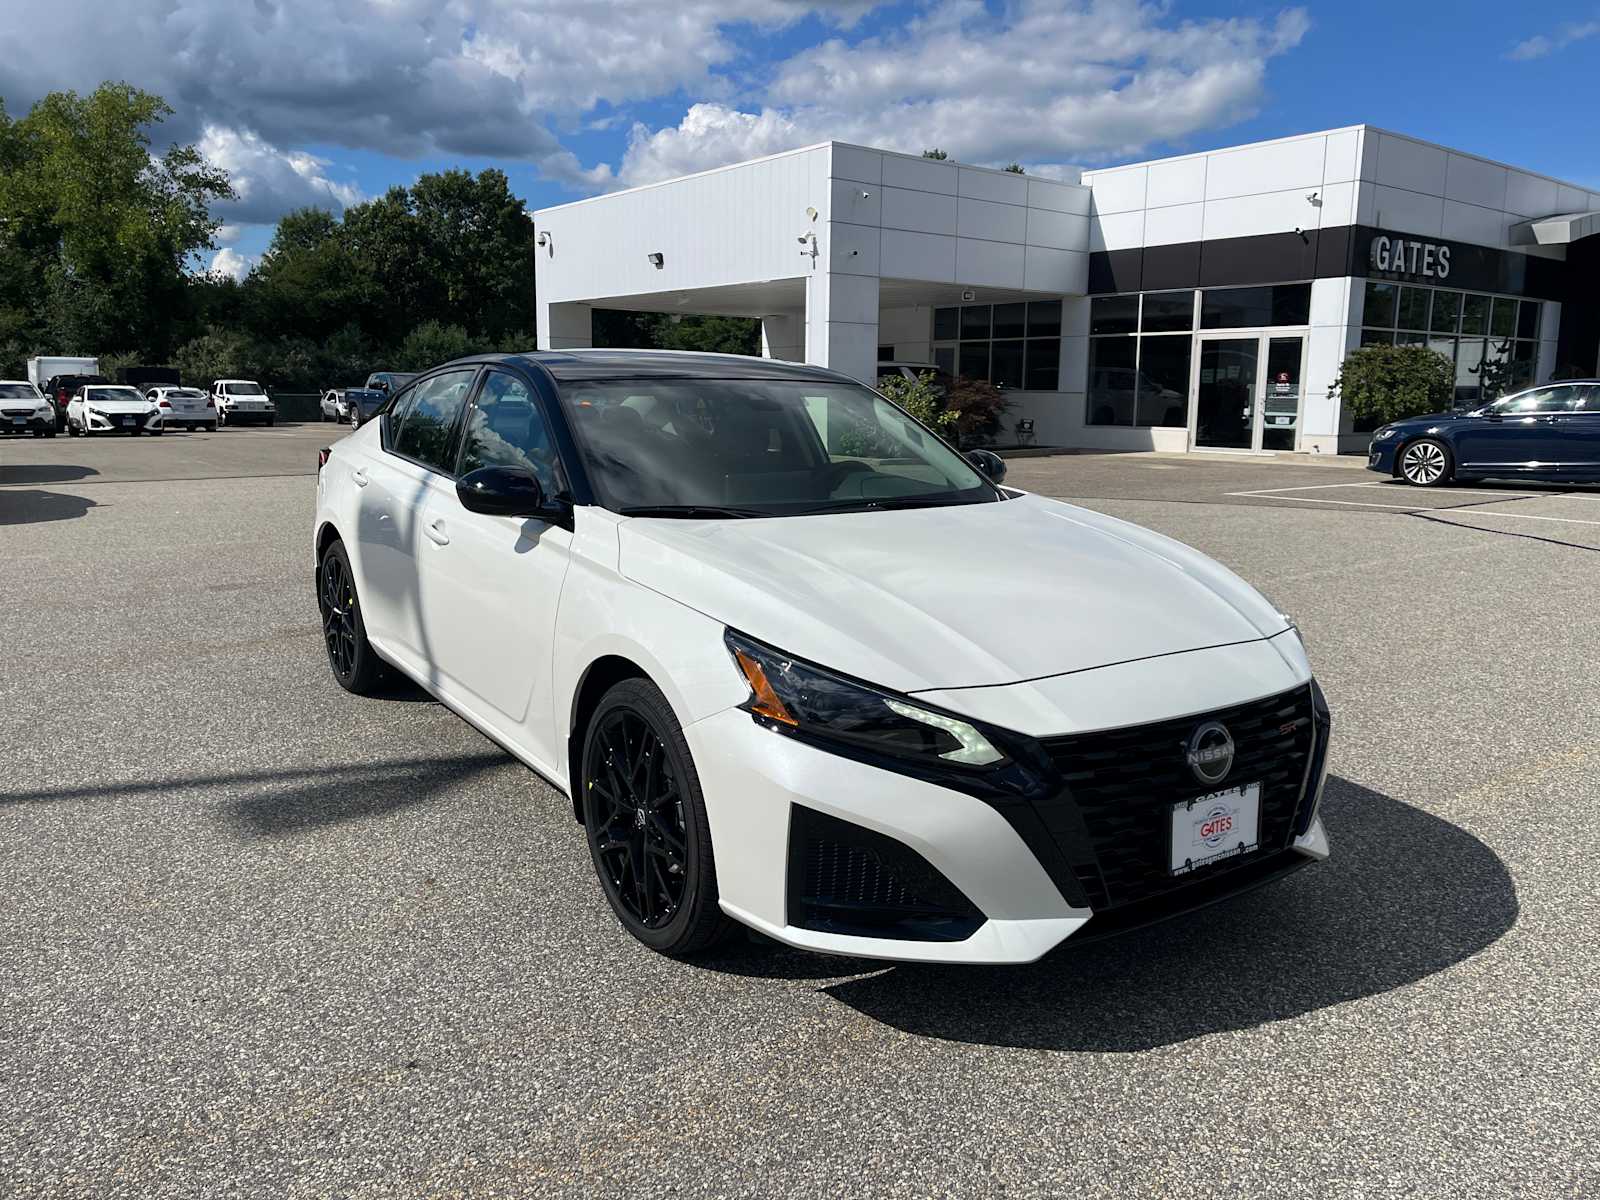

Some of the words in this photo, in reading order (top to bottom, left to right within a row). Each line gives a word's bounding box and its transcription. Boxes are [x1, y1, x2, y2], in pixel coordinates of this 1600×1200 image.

[1374, 236, 1451, 279] GATES
[1280, 721, 1297, 735] SR
[1200, 817, 1232, 837] GATES
